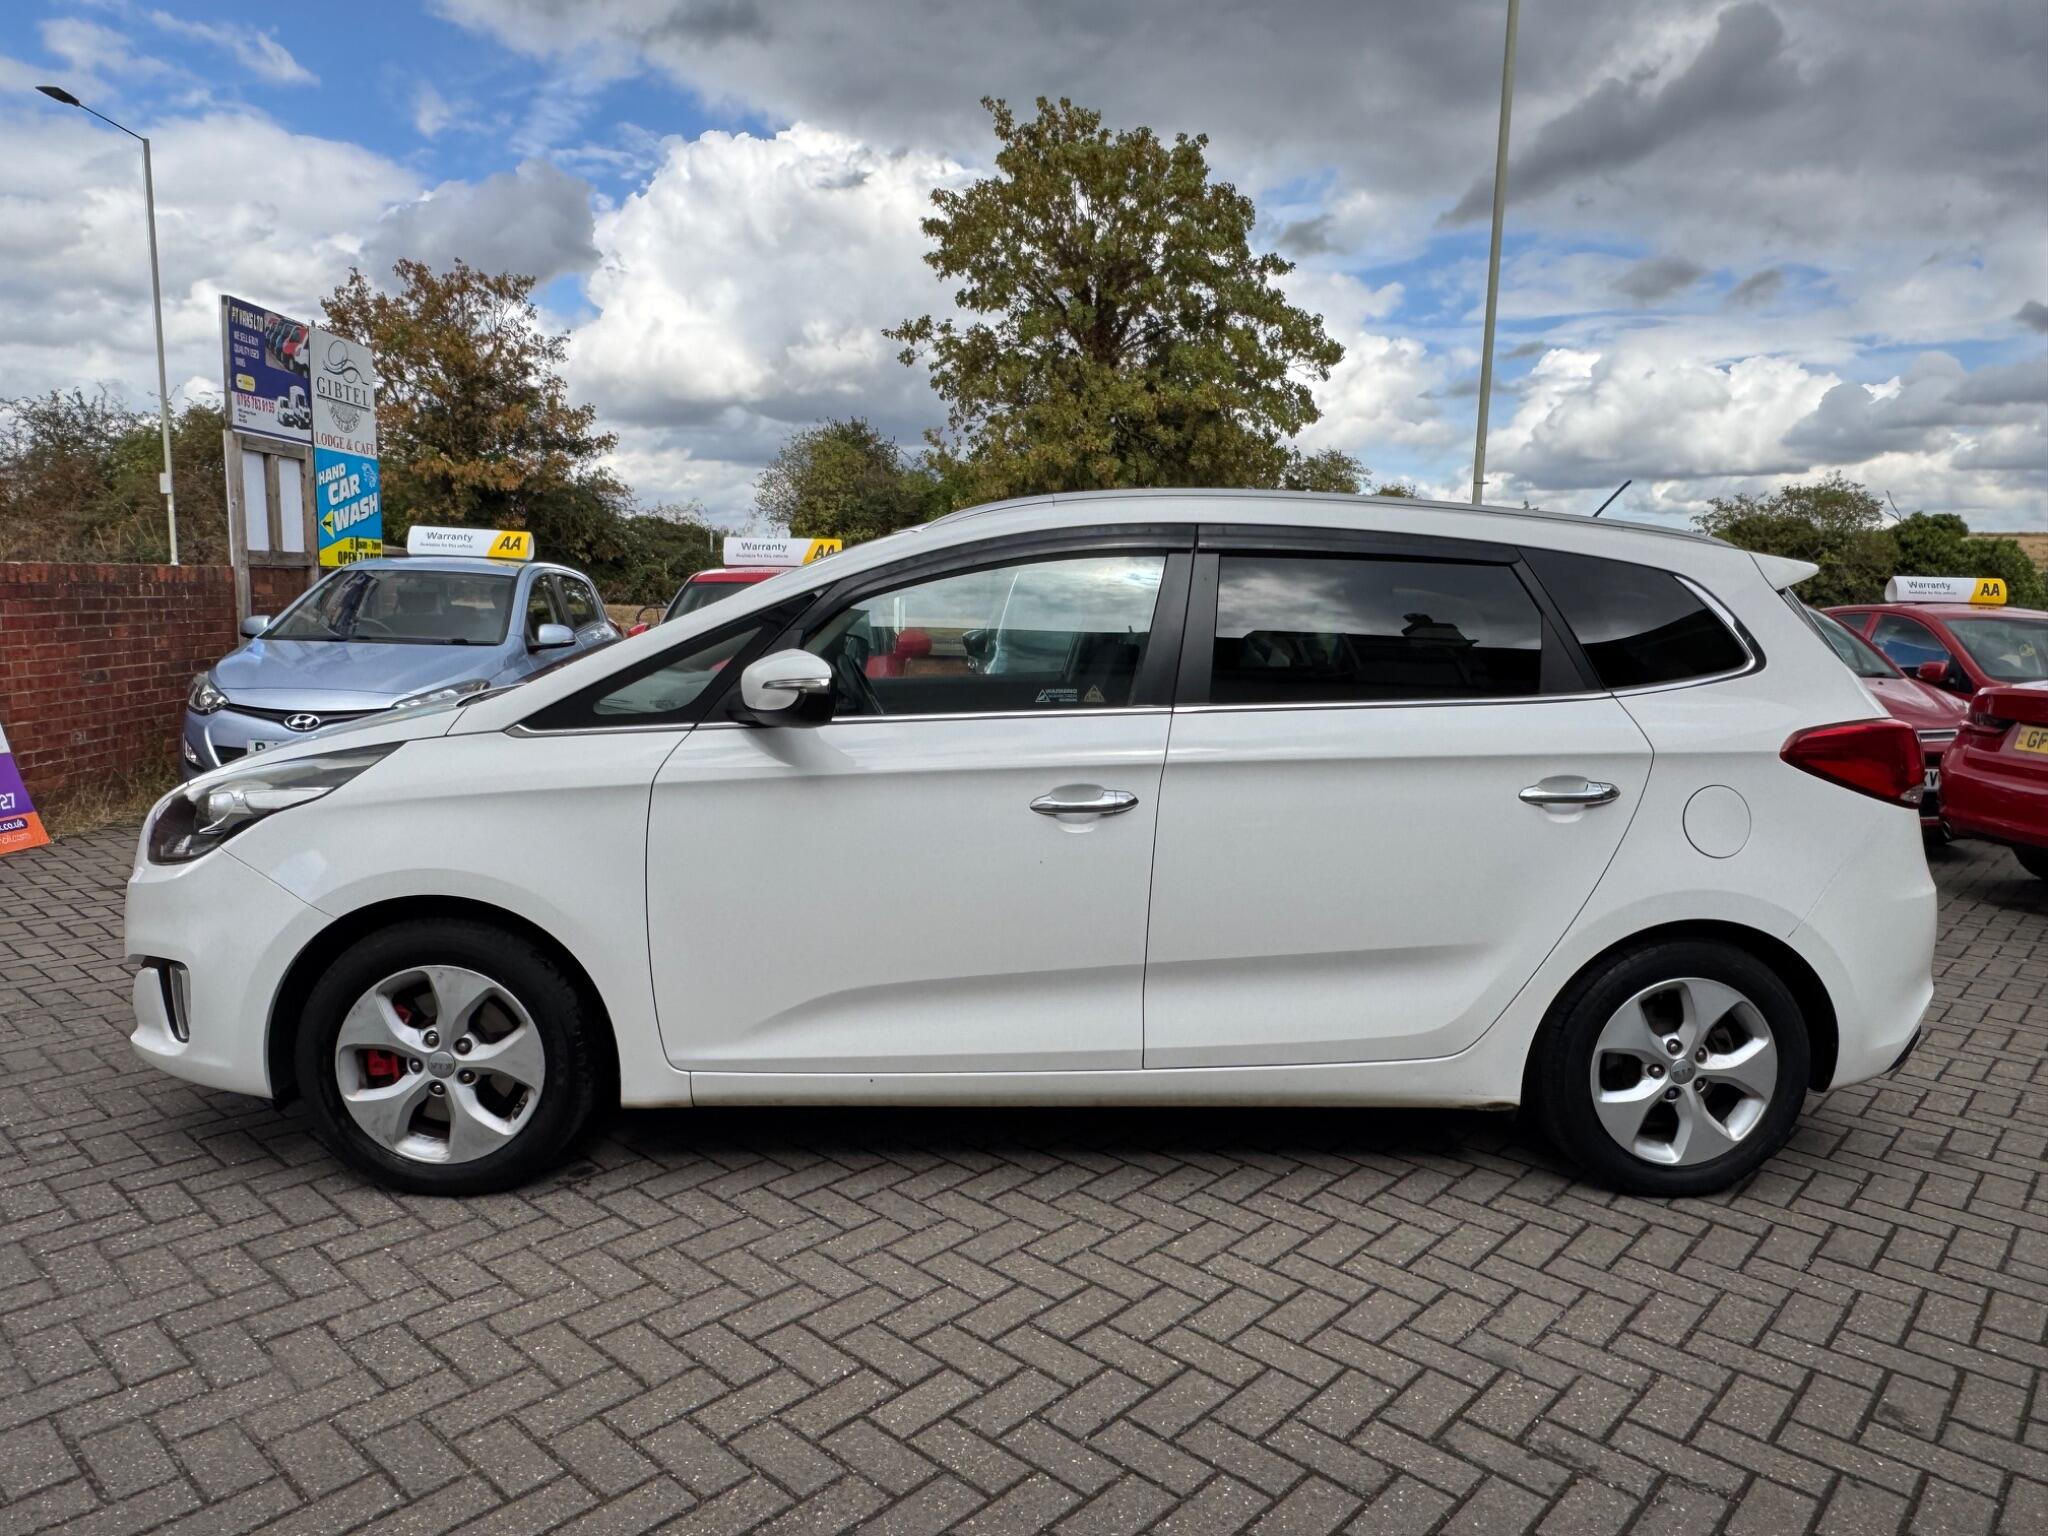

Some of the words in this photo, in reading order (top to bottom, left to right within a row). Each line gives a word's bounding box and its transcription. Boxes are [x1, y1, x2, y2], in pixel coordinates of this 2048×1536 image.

[317, 377, 370, 406] GIBTEL
[316, 432, 344, 449] LODGE
[346, 439, 353, 451] &
[318, 463, 346, 486] HAND
[328, 473, 360, 506] CAR
[334, 493, 378, 531] WASH
[427, 531, 473, 542] Warranty
[499, 535, 522, 550] AA
[741, 542, 787, 552] Warranty
[813, 545, 835, 559] AA
[1907, 580, 1951, 591] Warranty
[1980, 583, 2000, 596] AA
